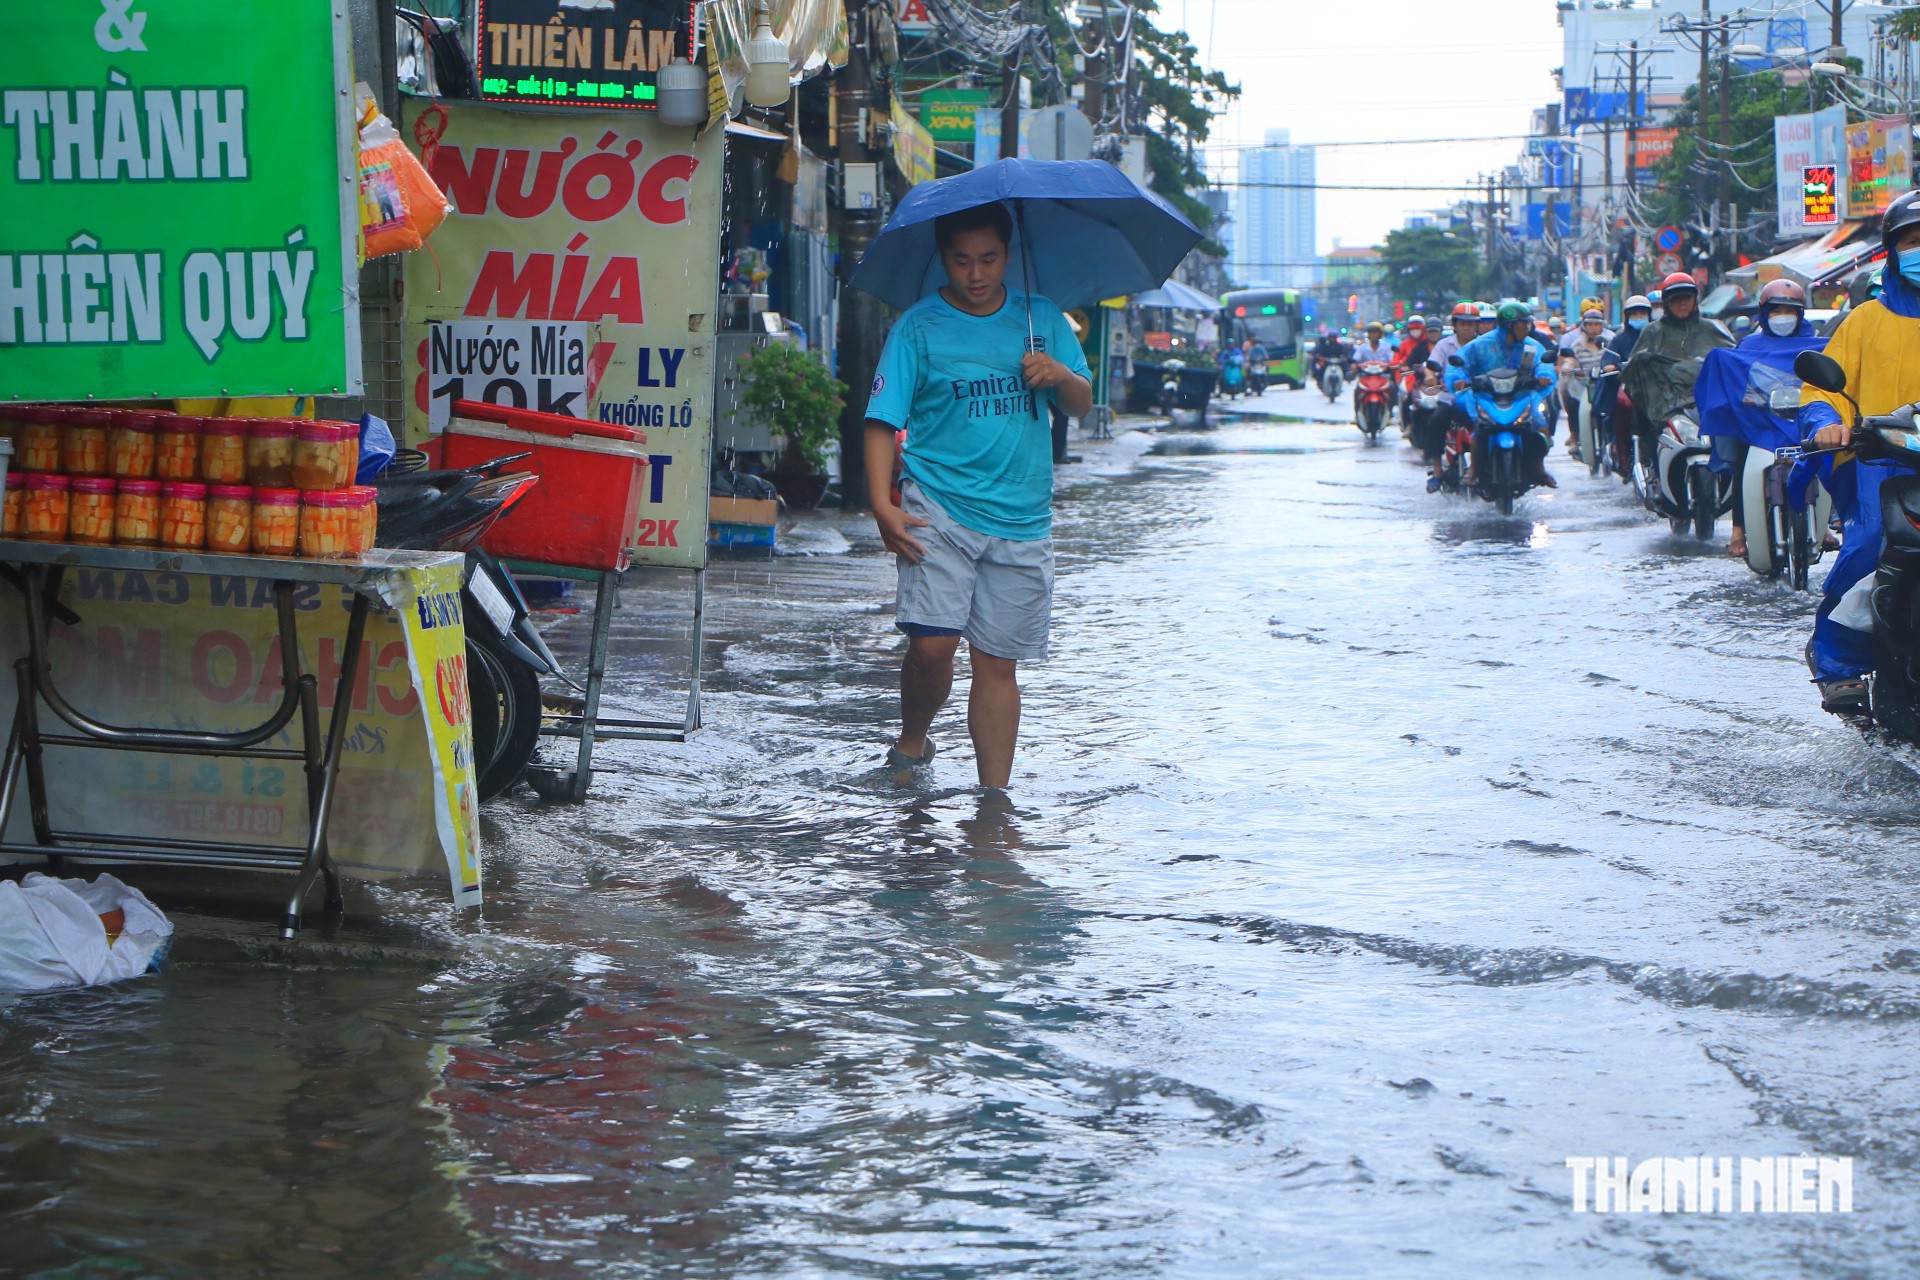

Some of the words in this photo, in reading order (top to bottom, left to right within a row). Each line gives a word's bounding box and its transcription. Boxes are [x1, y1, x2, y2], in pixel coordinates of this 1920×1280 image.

[94, 0, 148, 52] &
[487, 11, 592, 69] THIỀN
[603, 19, 677, 72] LÂM
[4, 69, 248, 180] THÀNH
[437, 130, 699, 224] NƯỚC
[0, 233, 163, 342] HIÊN
[183, 229, 314, 361] QUÝ
[463, 232, 643, 324] MÍA
[432, 325, 520, 375] Nước
[531, 325, 584, 375] Mía
[638, 347, 685, 388] LY
[601, 395, 663, 427] KHỔNG
[670, 398, 692, 427] LỒ
[968, 400, 988, 418] FLY
[995, 394, 1032, 415] BETTE
[637, 519, 679, 547] 2K
